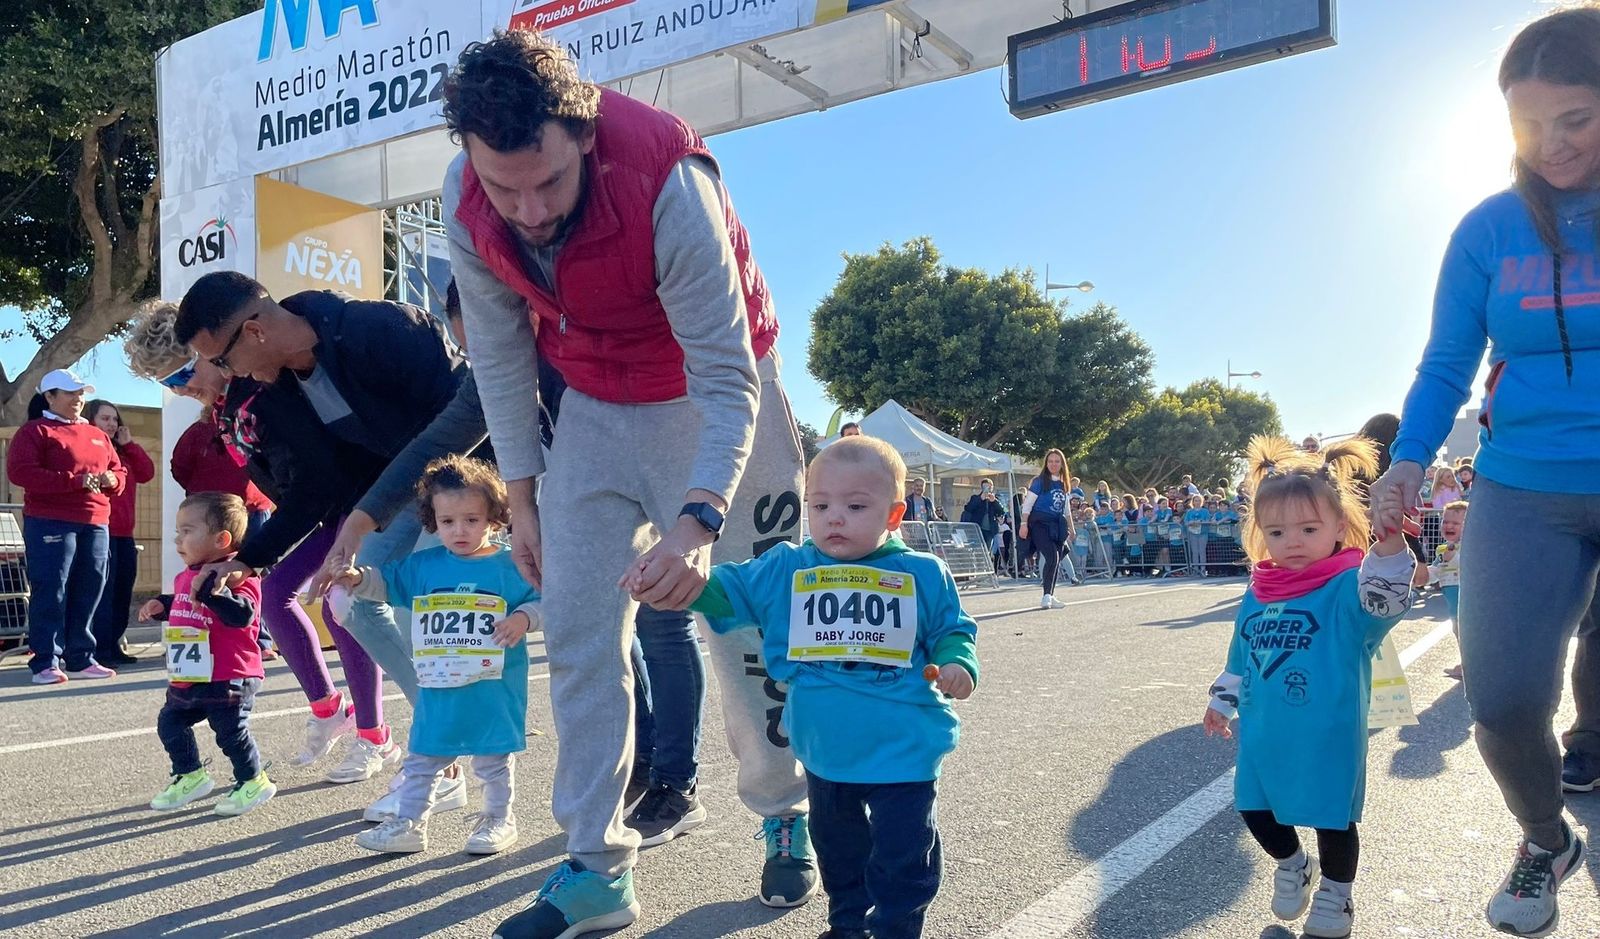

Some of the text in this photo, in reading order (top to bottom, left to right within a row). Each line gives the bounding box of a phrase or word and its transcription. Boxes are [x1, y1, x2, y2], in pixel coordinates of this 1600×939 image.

[534, 4, 575, 27] Prueba
[591, 21, 645, 55] RUIZ
[255, 27, 451, 108] Medio Maratón
[257, 62, 450, 151] Almería 2022
[178, 230, 225, 268] CASI
[305, 236, 328, 249] GRUPO
[284, 241, 363, 290] NEXA
[850, 575, 869, 584] 2022
[803, 592, 902, 628] 10401
[419, 611, 495, 636] 10213
[446, 637, 482, 646] CAMPOS
[815, 630, 885, 643] BABY JORGE
[1251, 634, 1313, 650] UNNER
[169, 643, 202, 664] 74
